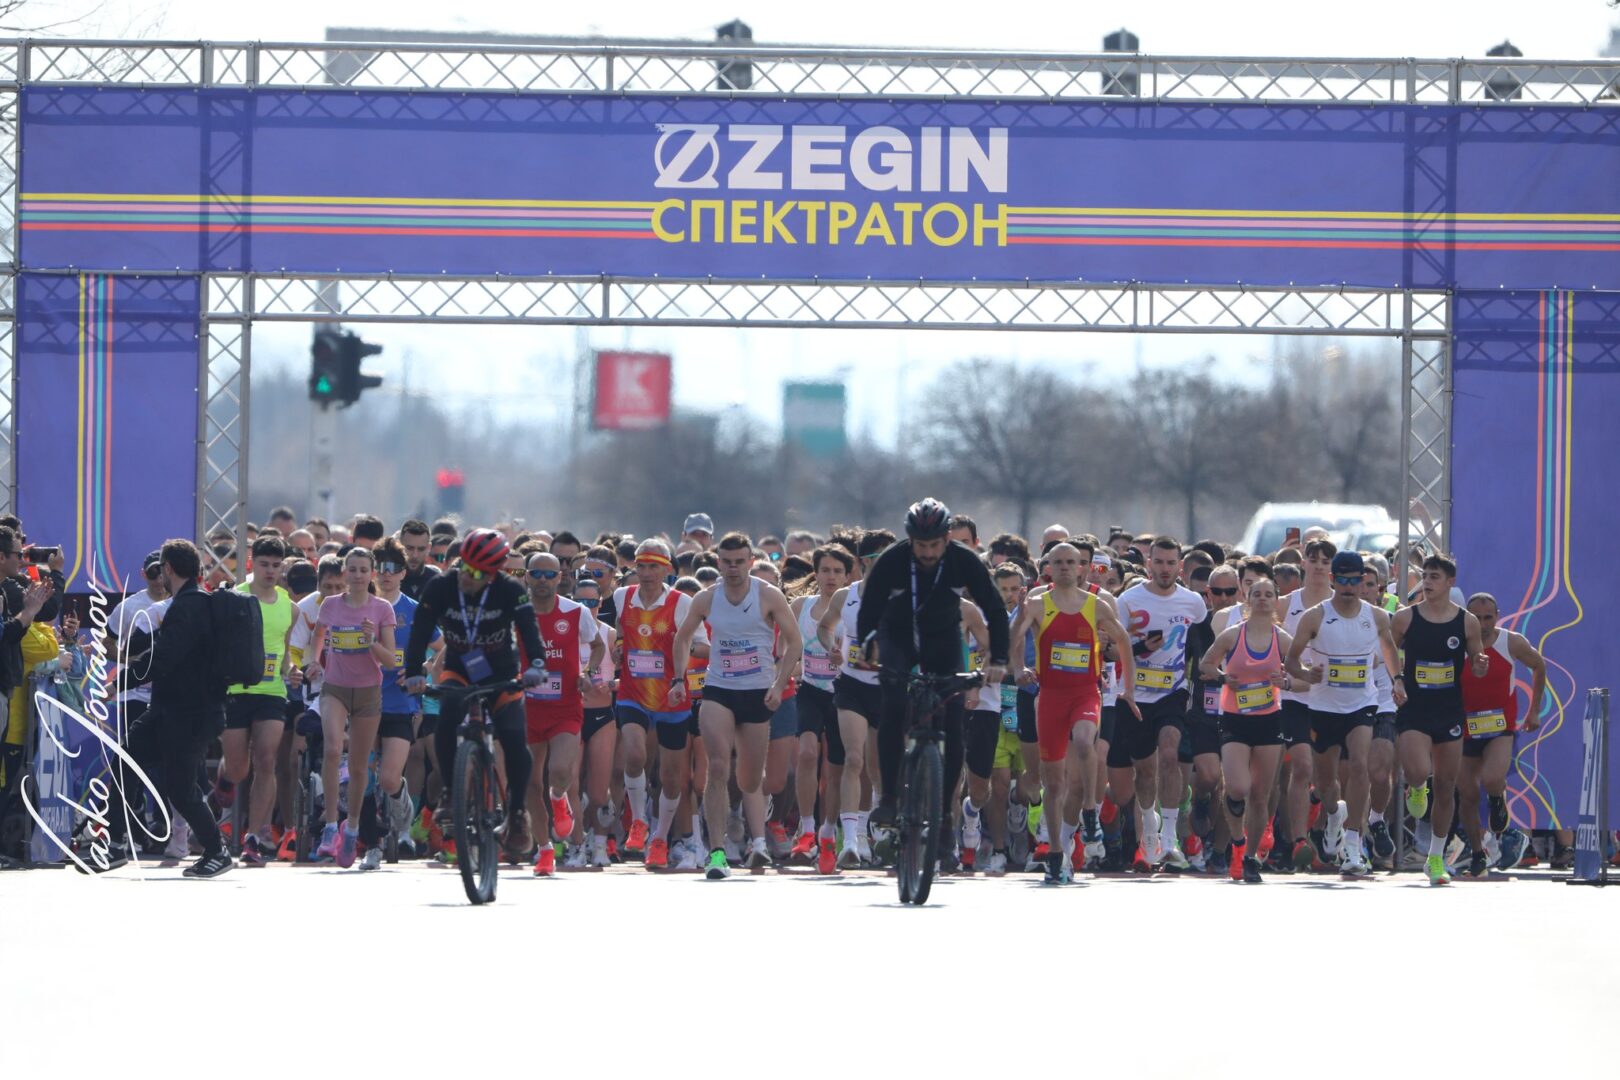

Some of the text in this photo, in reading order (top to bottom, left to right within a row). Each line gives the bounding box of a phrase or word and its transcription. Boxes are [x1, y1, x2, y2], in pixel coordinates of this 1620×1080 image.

[728, 123, 1009, 193] ZEGIN
[650, 198, 1008, 247] СПЕКТРАТОН
[545, 649, 563, 659] РЕЦ
